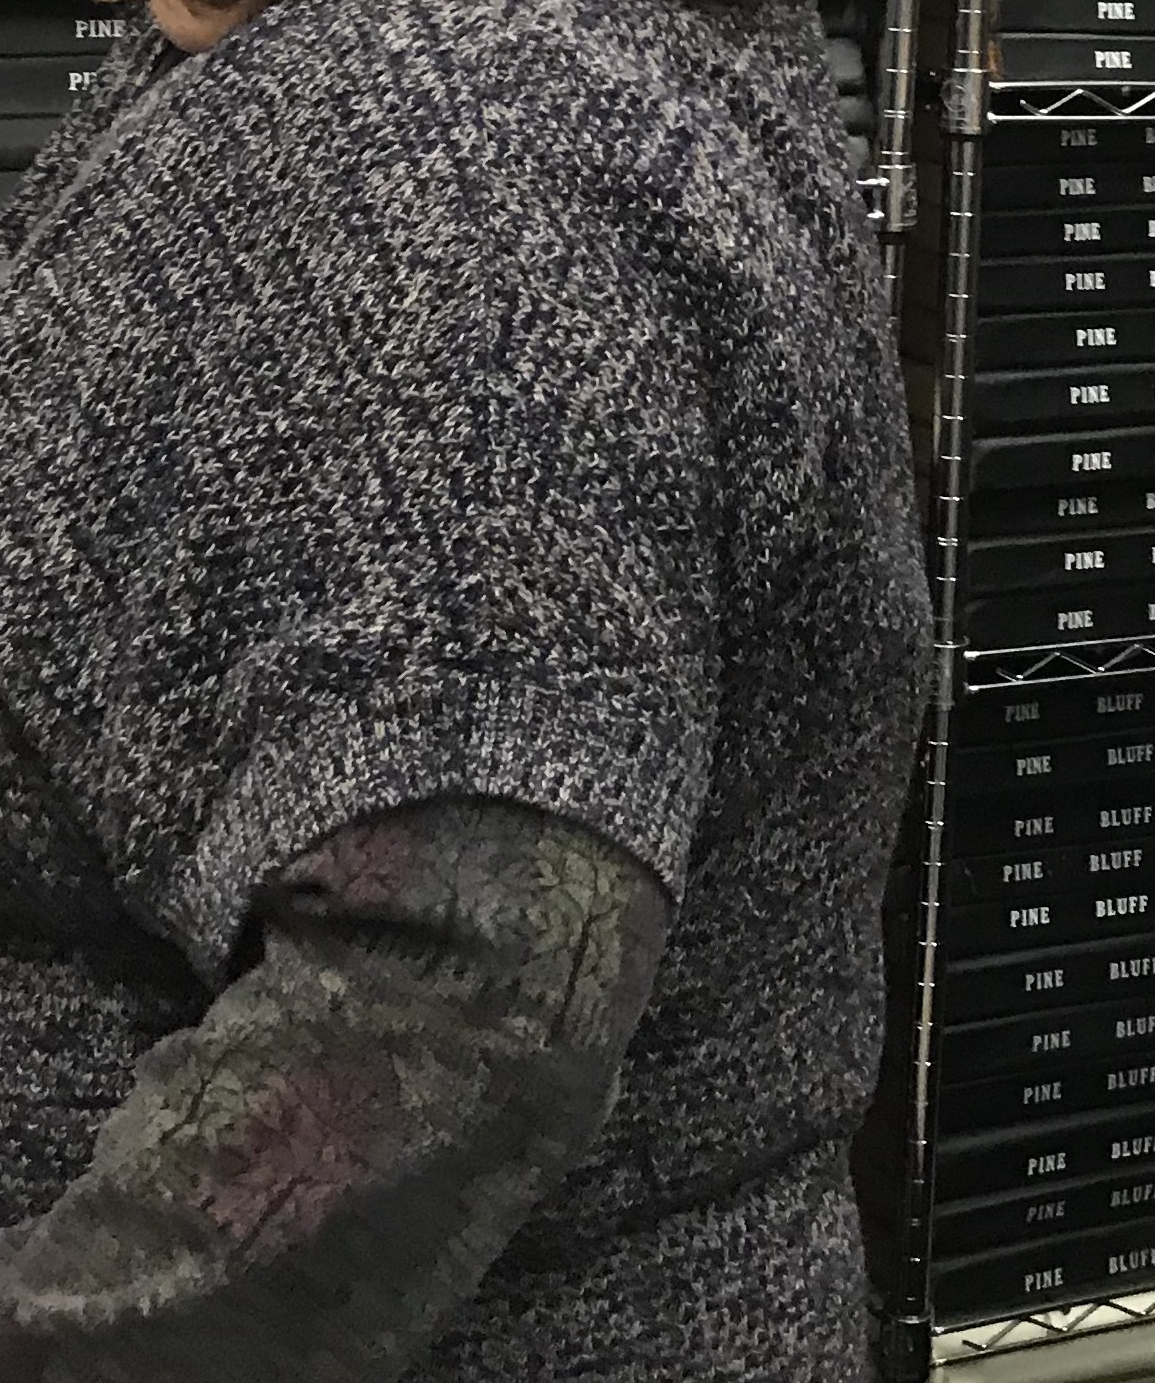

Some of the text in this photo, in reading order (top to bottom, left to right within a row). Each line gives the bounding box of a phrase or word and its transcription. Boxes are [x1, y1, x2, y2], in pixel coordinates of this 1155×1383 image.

[1097, 1, 1136, 20] PINE
[1094, 50, 1133, 69] PINE
[1060, 128, 1098, 147] PINE
[1059, 177, 1096, 196] PINE
[1063, 222, 1101, 242] PINE
[1065, 272, 1106, 291] PINE
[1076, 327, 1117, 347] PINE
[1069, 384, 1110, 405] PINE
[1071, 451, 1112, 472] PINE
[1057, 496, 1099, 517] PINE
[1064, 550, 1105, 571] PINE
[1057, 609, 1094, 631] PINE
[1005, 693, 1143, 723] PINE BLUFF
[1016, 744, 1153, 776] PINE BLUFF
[1014, 806, 1153, 837] PINE BLUFF
[1003, 849, 1143, 883] PINE BLUFF
[1010, 895, 1149, 928] PINE BLUFF
[1025, 969, 1064, 992] PINE
[1032, 1030, 1071, 1052] PINE
[1023, 1081, 1062, 1105] PINE
[1027, 1152, 1066, 1176] PINE
[1026, 1200, 1066, 1222] PINE
[1025, 1267, 1064, 1293] PINE
